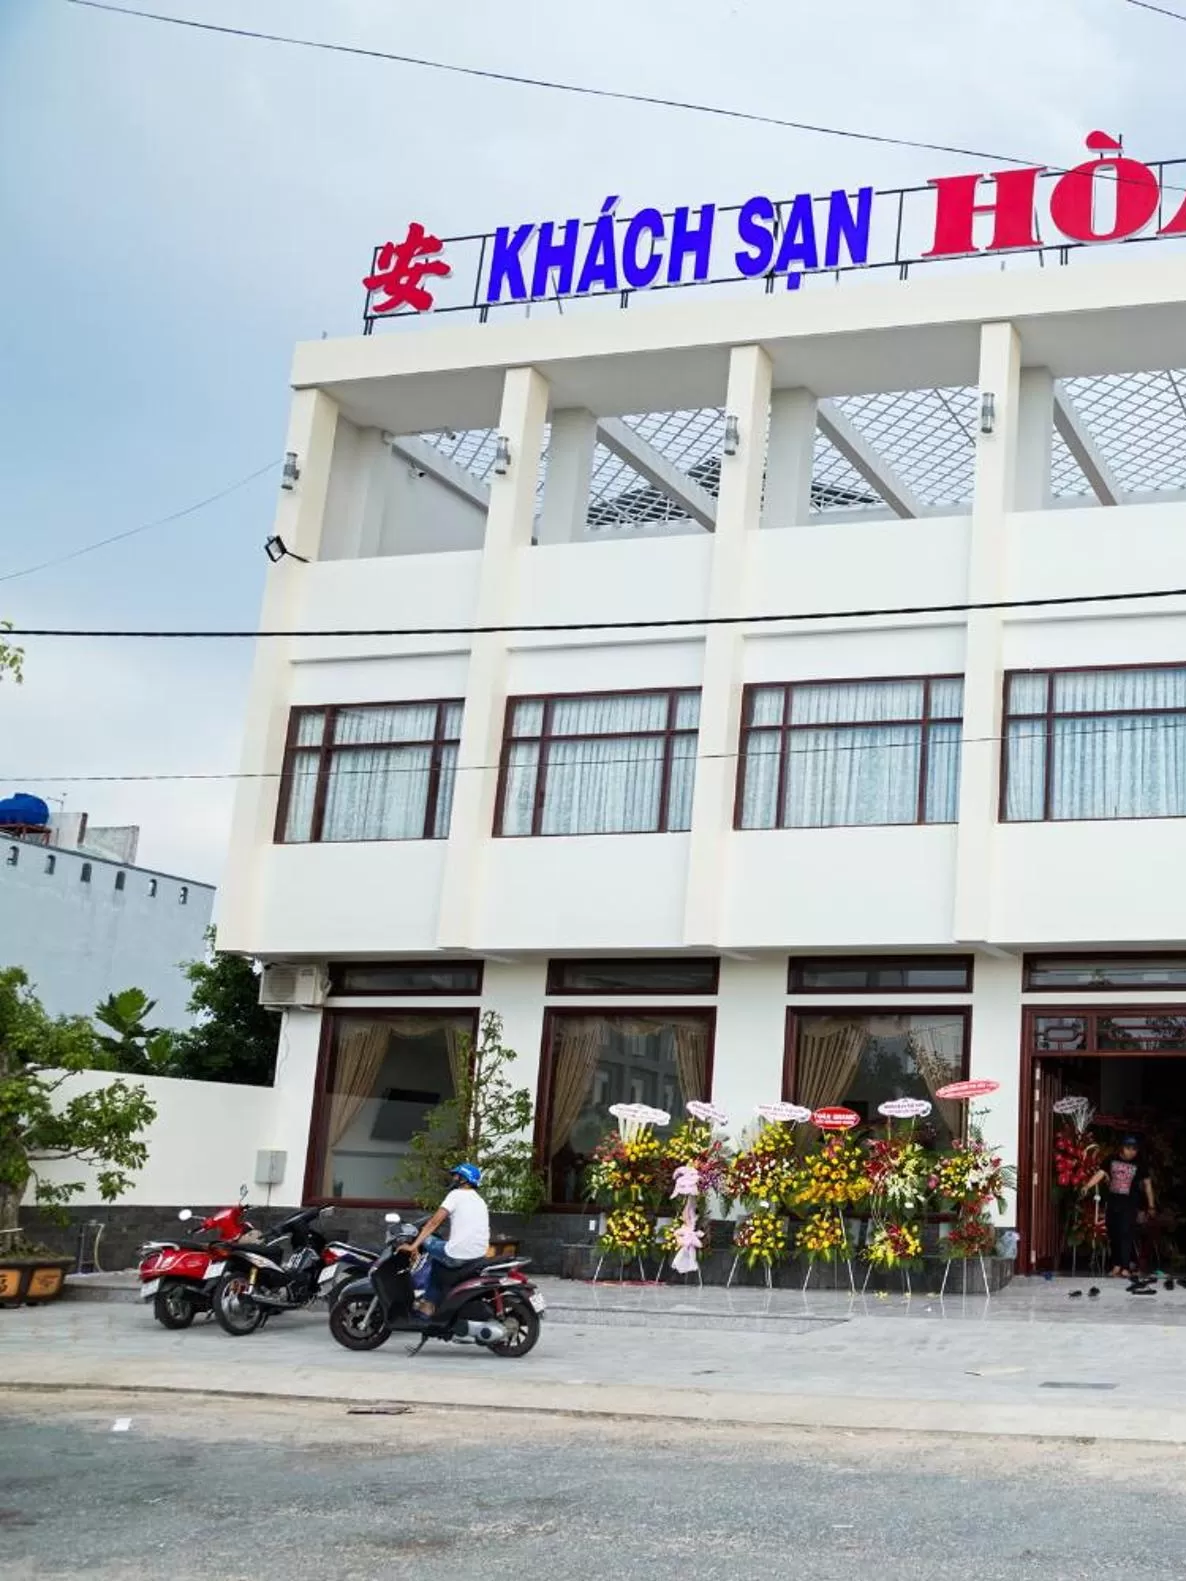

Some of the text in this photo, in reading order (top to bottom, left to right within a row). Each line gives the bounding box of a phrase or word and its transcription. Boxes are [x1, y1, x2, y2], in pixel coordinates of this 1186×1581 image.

[363, 221, 452, 313] 安
[486, 194, 716, 304] KHÁCH
[735, 187, 874, 291] SẠN
